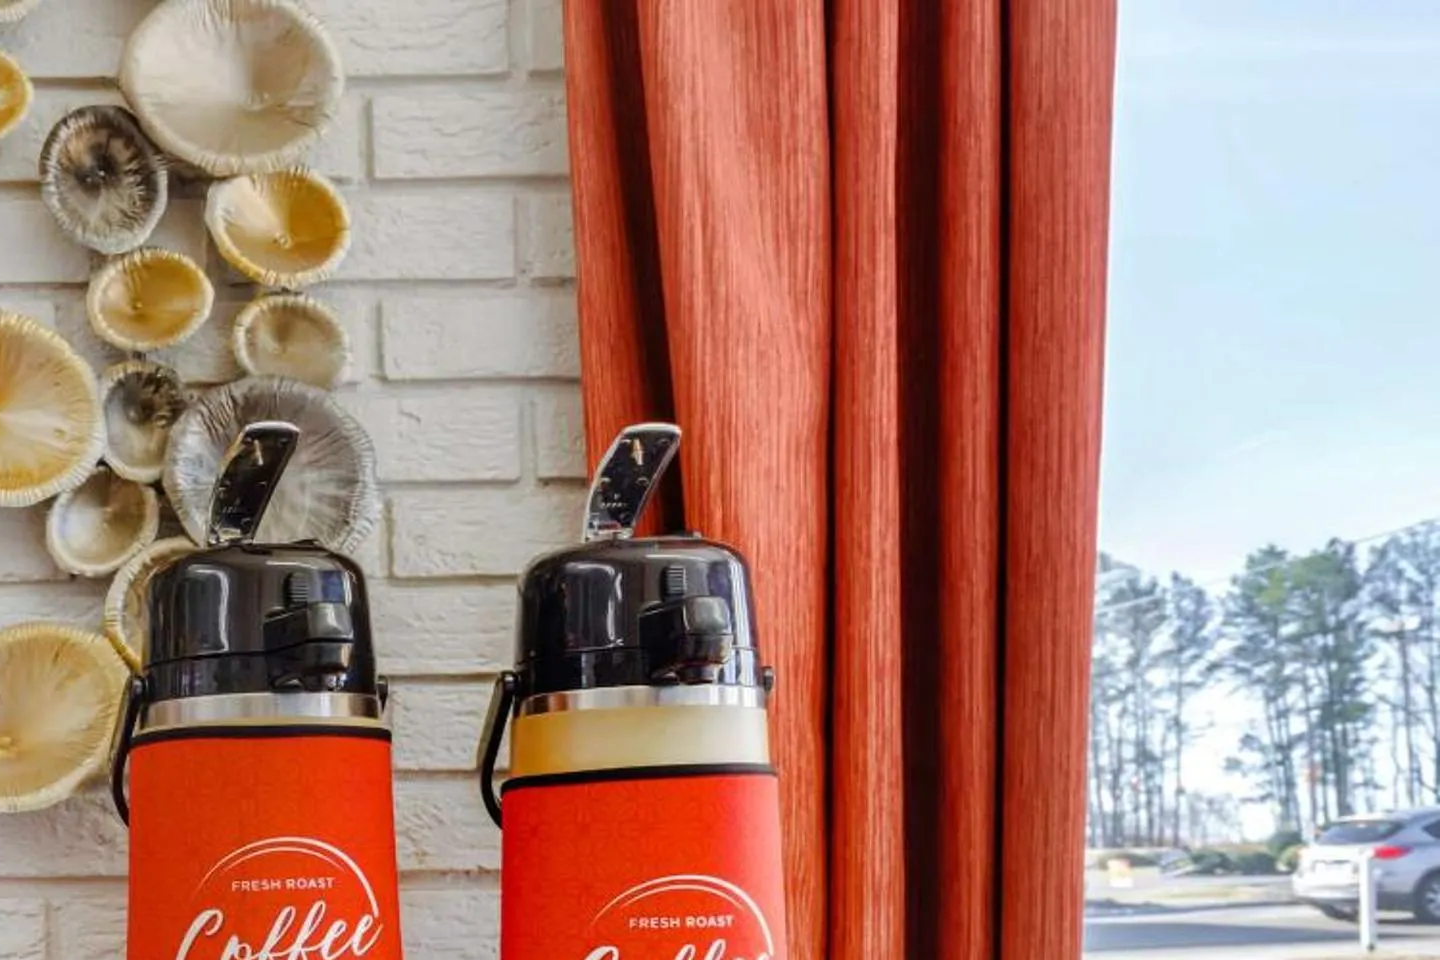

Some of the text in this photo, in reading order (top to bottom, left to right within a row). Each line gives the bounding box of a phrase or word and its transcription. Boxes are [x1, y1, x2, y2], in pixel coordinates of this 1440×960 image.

[231, 877, 336, 892] FRESH ROAST
[629, 915, 734, 928] FRESH ROAST
